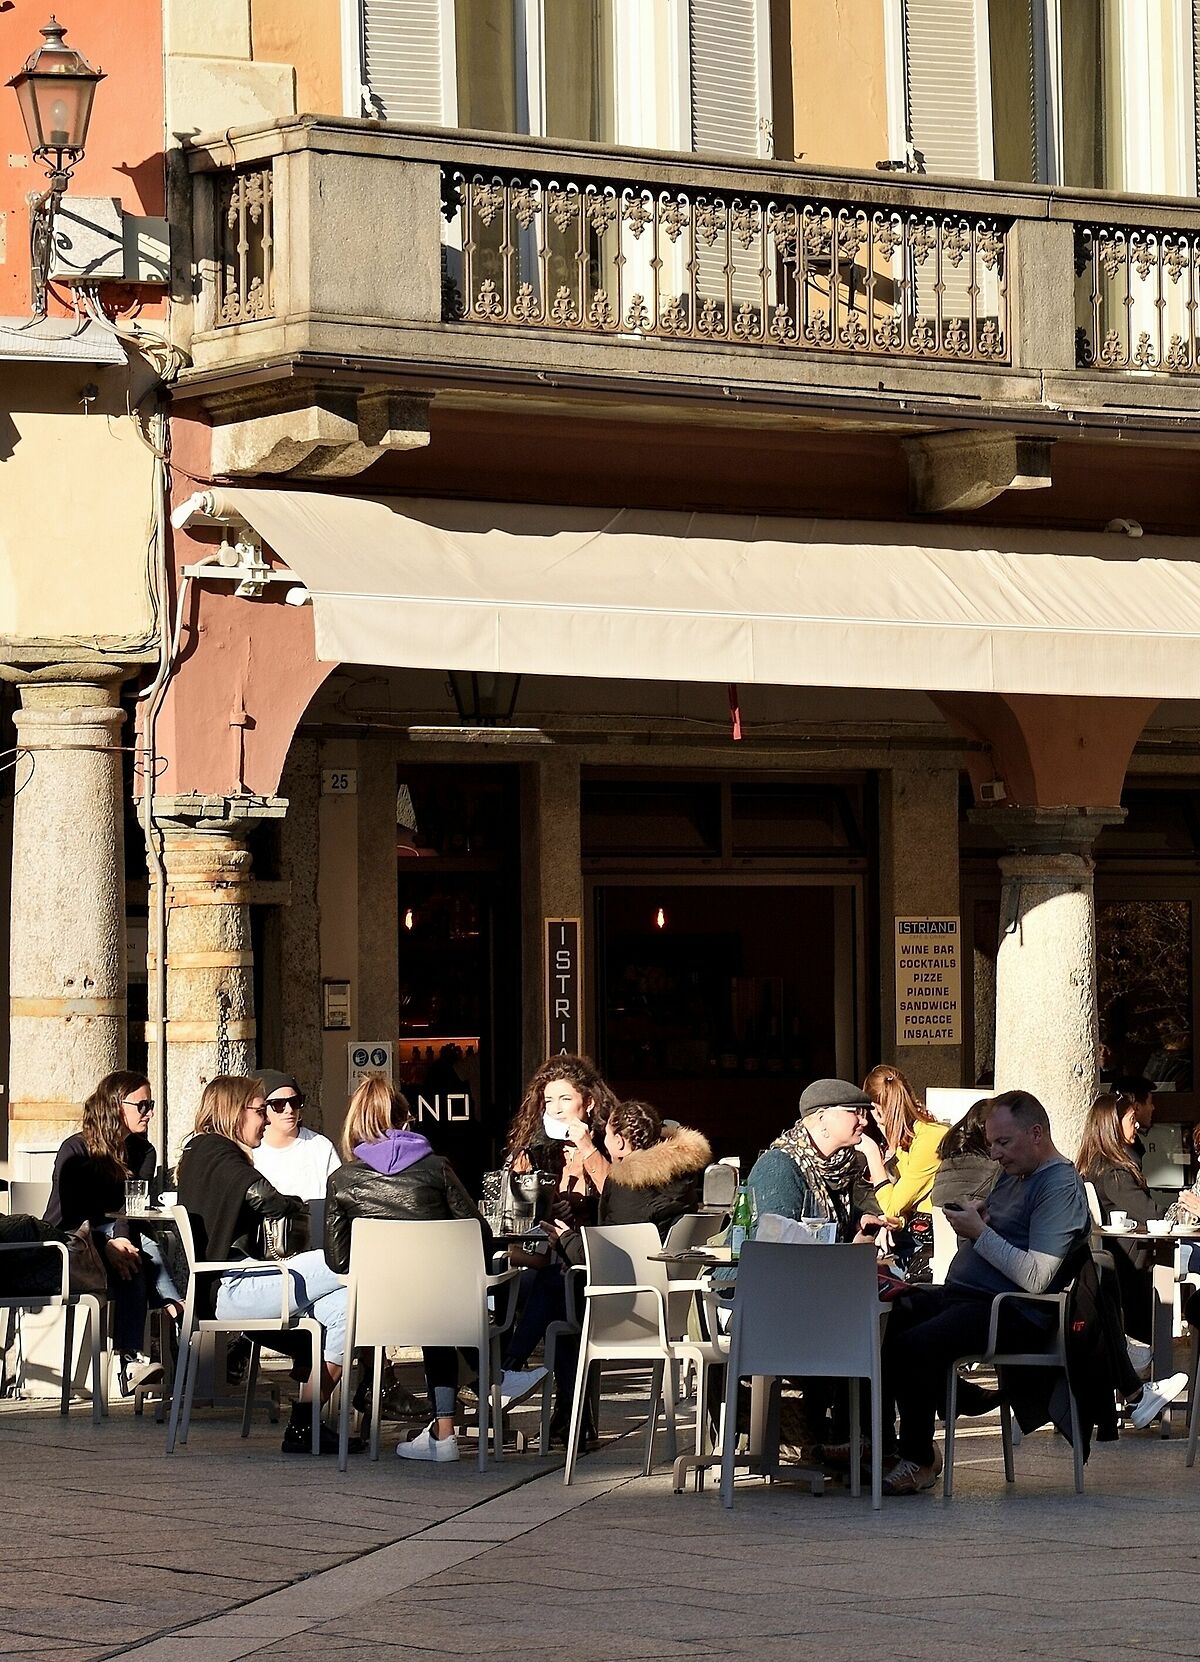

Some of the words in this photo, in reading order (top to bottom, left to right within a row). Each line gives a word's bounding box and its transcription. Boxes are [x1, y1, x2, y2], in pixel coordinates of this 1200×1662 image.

[331, 773, 348, 789] 25
[900, 922, 955, 933] ISTRIANO
[901, 945, 928, 954] WINE
[934, 945, 954, 954] BAR
[900, 959, 956, 968] COCKTAILS
[914, 973, 942, 982] PIZZE
[907, 987, 949, 996] PIADINE
[900, 1001, 957, 1010] SANDWICH
[905, 1015, 952, 1024] FOCACCE
[904, 1029, 953, 1038] INSALATE
[418, 1094, 470, 1122] NO
